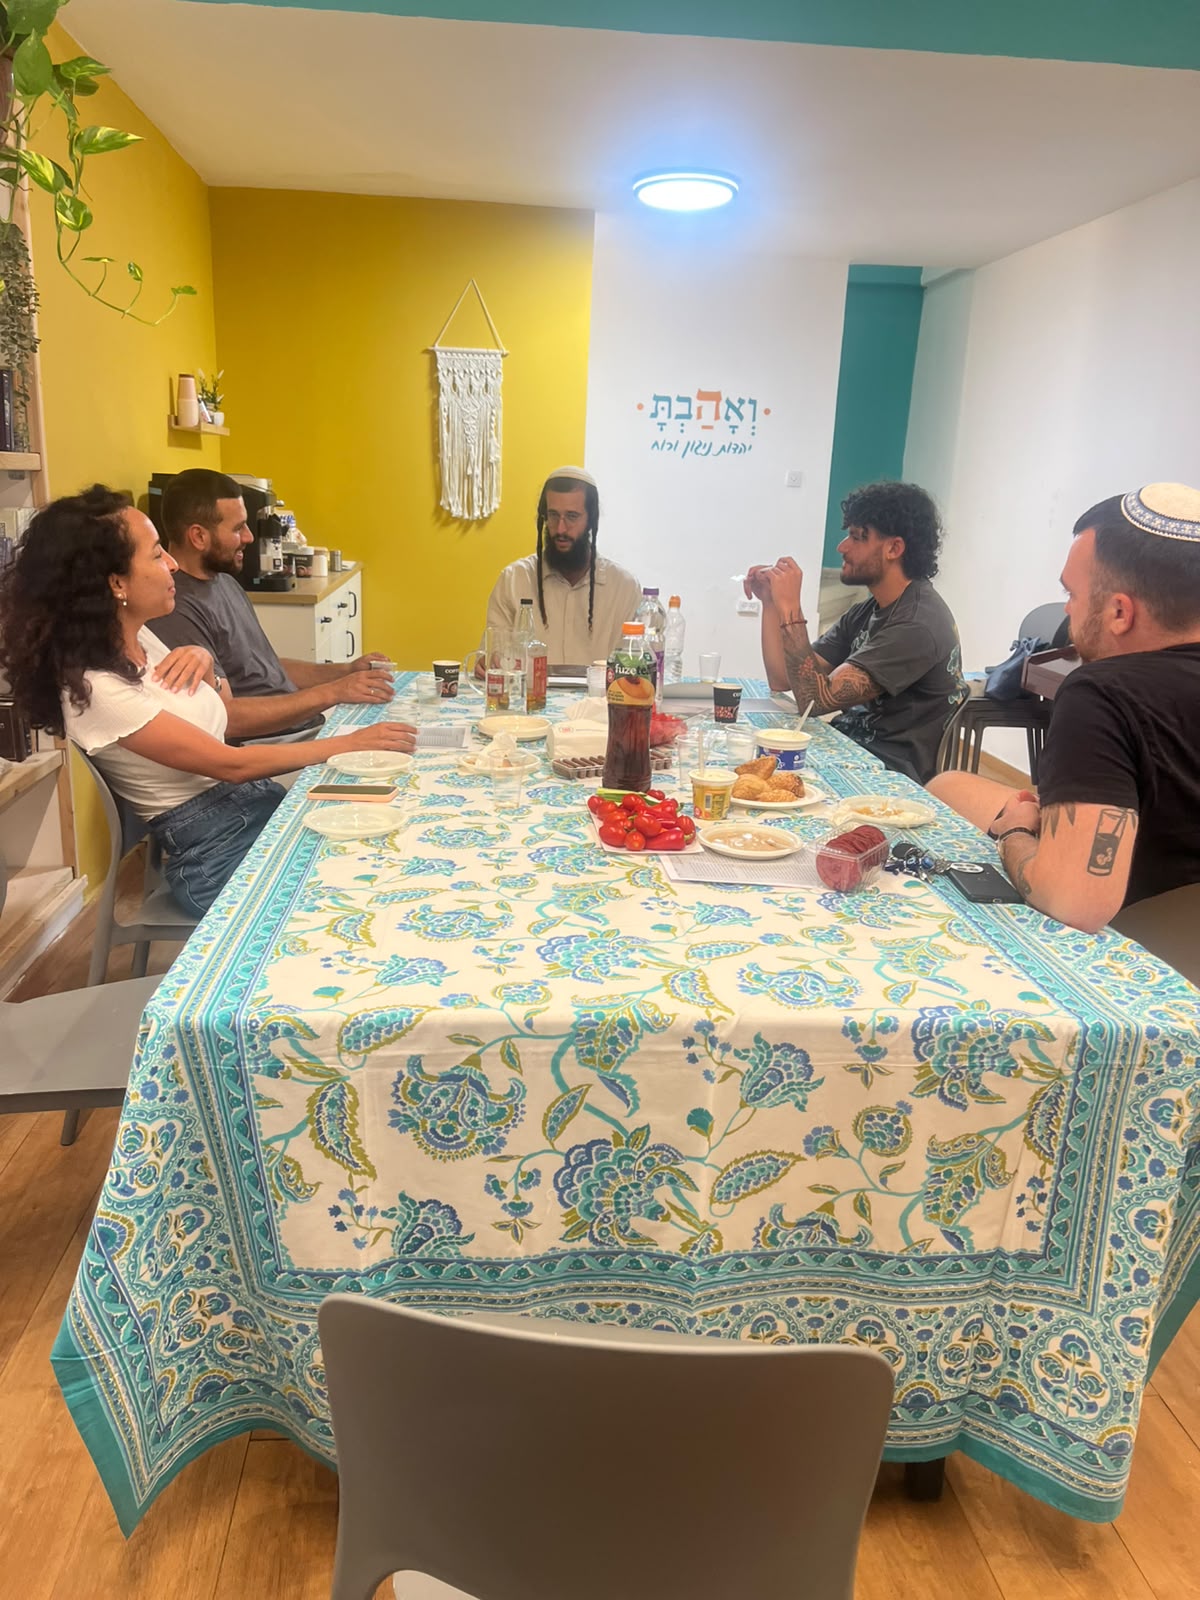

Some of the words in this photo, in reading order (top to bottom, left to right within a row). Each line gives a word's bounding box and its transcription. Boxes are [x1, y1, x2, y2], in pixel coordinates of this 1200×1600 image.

[650, 439, 680, 452] ורוח
[681, 440, 713, 459] ניגון
[712, 442, 753, 457] יהדות
